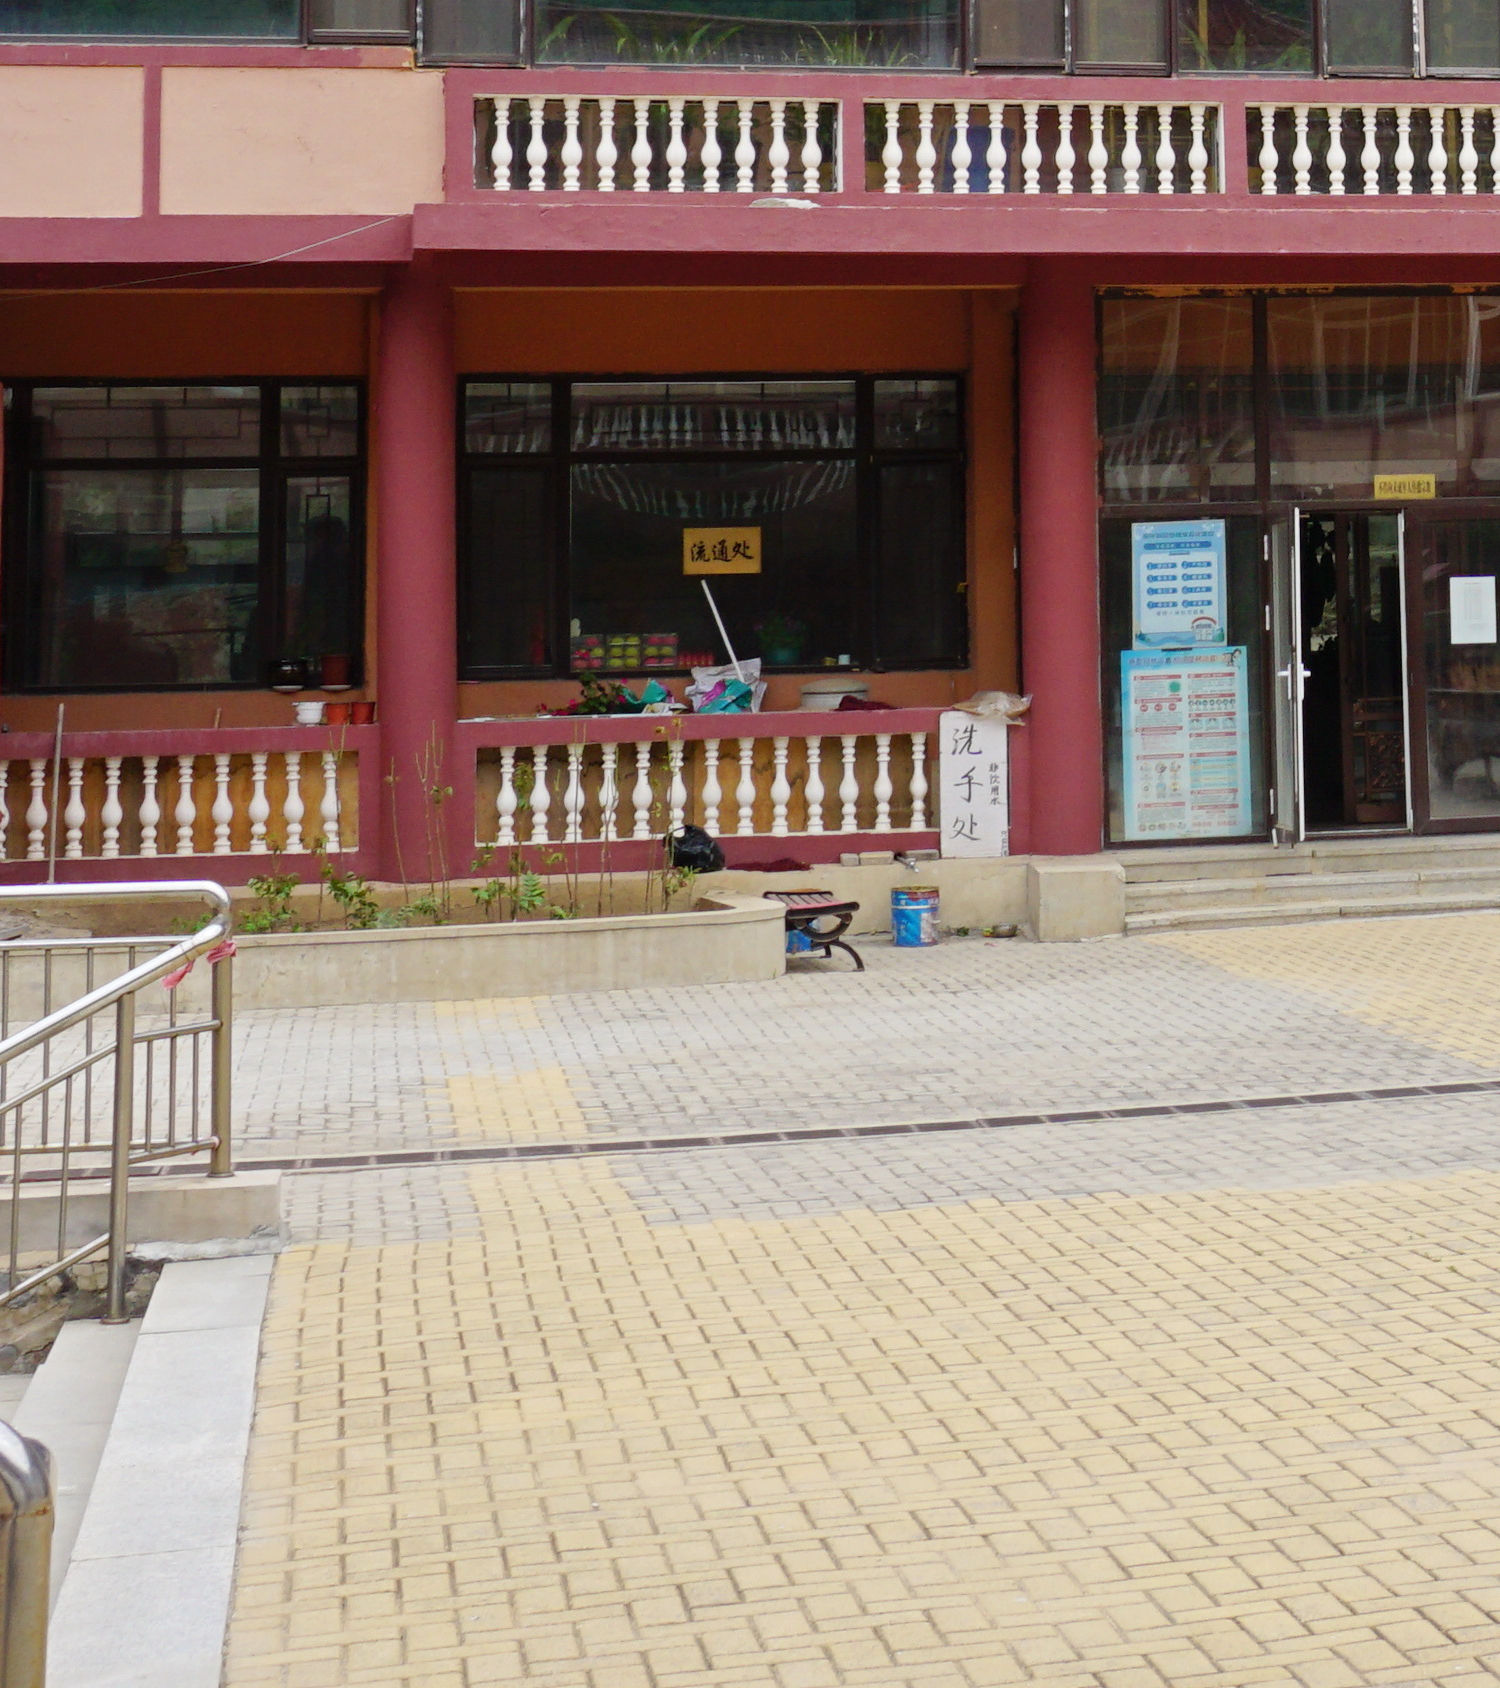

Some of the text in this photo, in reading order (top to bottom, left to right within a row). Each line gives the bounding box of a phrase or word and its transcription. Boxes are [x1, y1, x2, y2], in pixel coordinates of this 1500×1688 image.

[690, 539, 755, 562] 流通处
[950, 723, 983, 841] 洗手处
